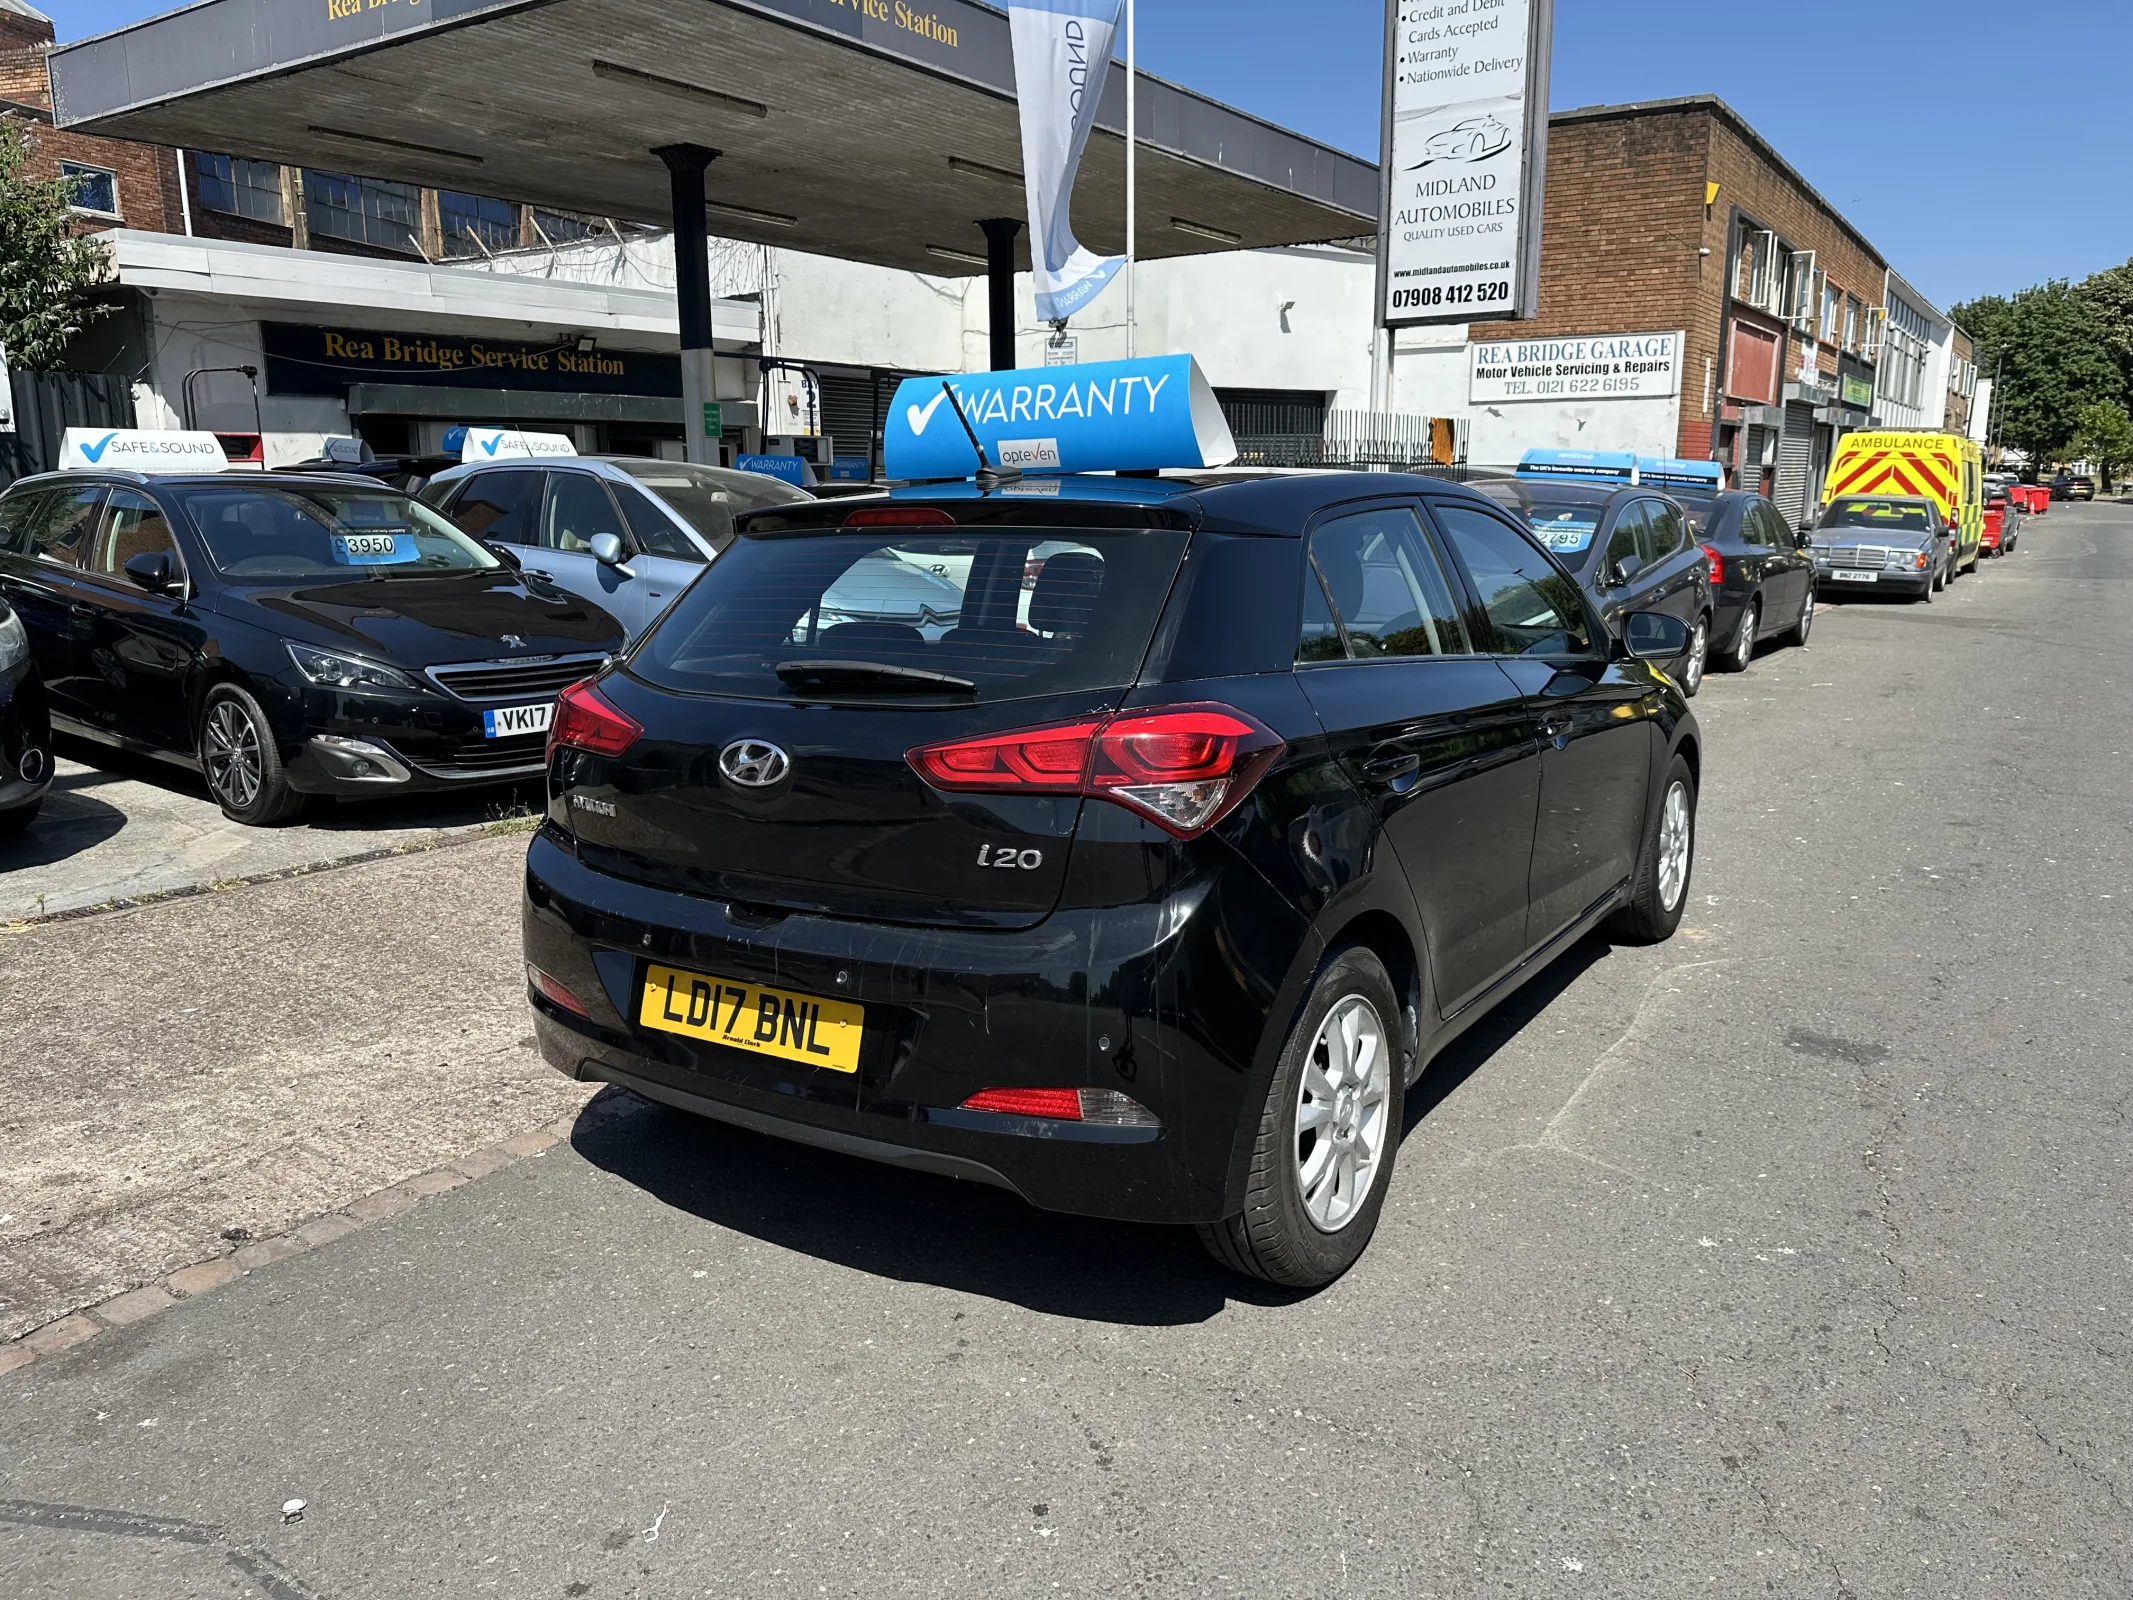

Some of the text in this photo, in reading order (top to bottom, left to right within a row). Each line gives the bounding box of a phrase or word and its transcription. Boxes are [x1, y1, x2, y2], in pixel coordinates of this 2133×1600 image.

[894, 1, 959, 47] Station
[1409, 6, 1444, 23] Credit
[1447, 3, 1468, 16] and
[1408, 15, 1498, 43] Cards Accepted
[1408, 46, 1458, 64] Warranty
[1407, 56, 1523, 84] Nationwide Delivery
[1415, 174, 1496, 198] MIDLAND
[1395, 198, 1515, 225] AUTOMOBILES
[1404, 222, 1503, 242] QUALITY USED CARS
[1394, 260, 1510, 278] www.midlandautomobiles.co.uk
[1392, 281, 1509, 308] 07908 412 520
[324, 333, 625, 375] Rea Bridge Service Station
[1478, 338, 1671, 364] REA BRIDGE GARAGE
[1476, 360, 1670, 379] Motor Vehicle Servicing & Repairs
[801, 380, 818, 388] BY
[1505, 377, 1639, 394] TEL. 0121 622 6195
[957, 374, 1170, 424] WARRANTY
[111, 441, 215, 454] SAFE&SOUND
[1002, 442, 1056, 465] opteven
[1850, 437, 1944, 450] AMBULANCE
[751, 460, 798, 471] WARRANTY
[502, 707, 546, 730] VK17
[977, 844, 1042, 870] i20
[663, 974, 830, 1056] LD17 BNL
